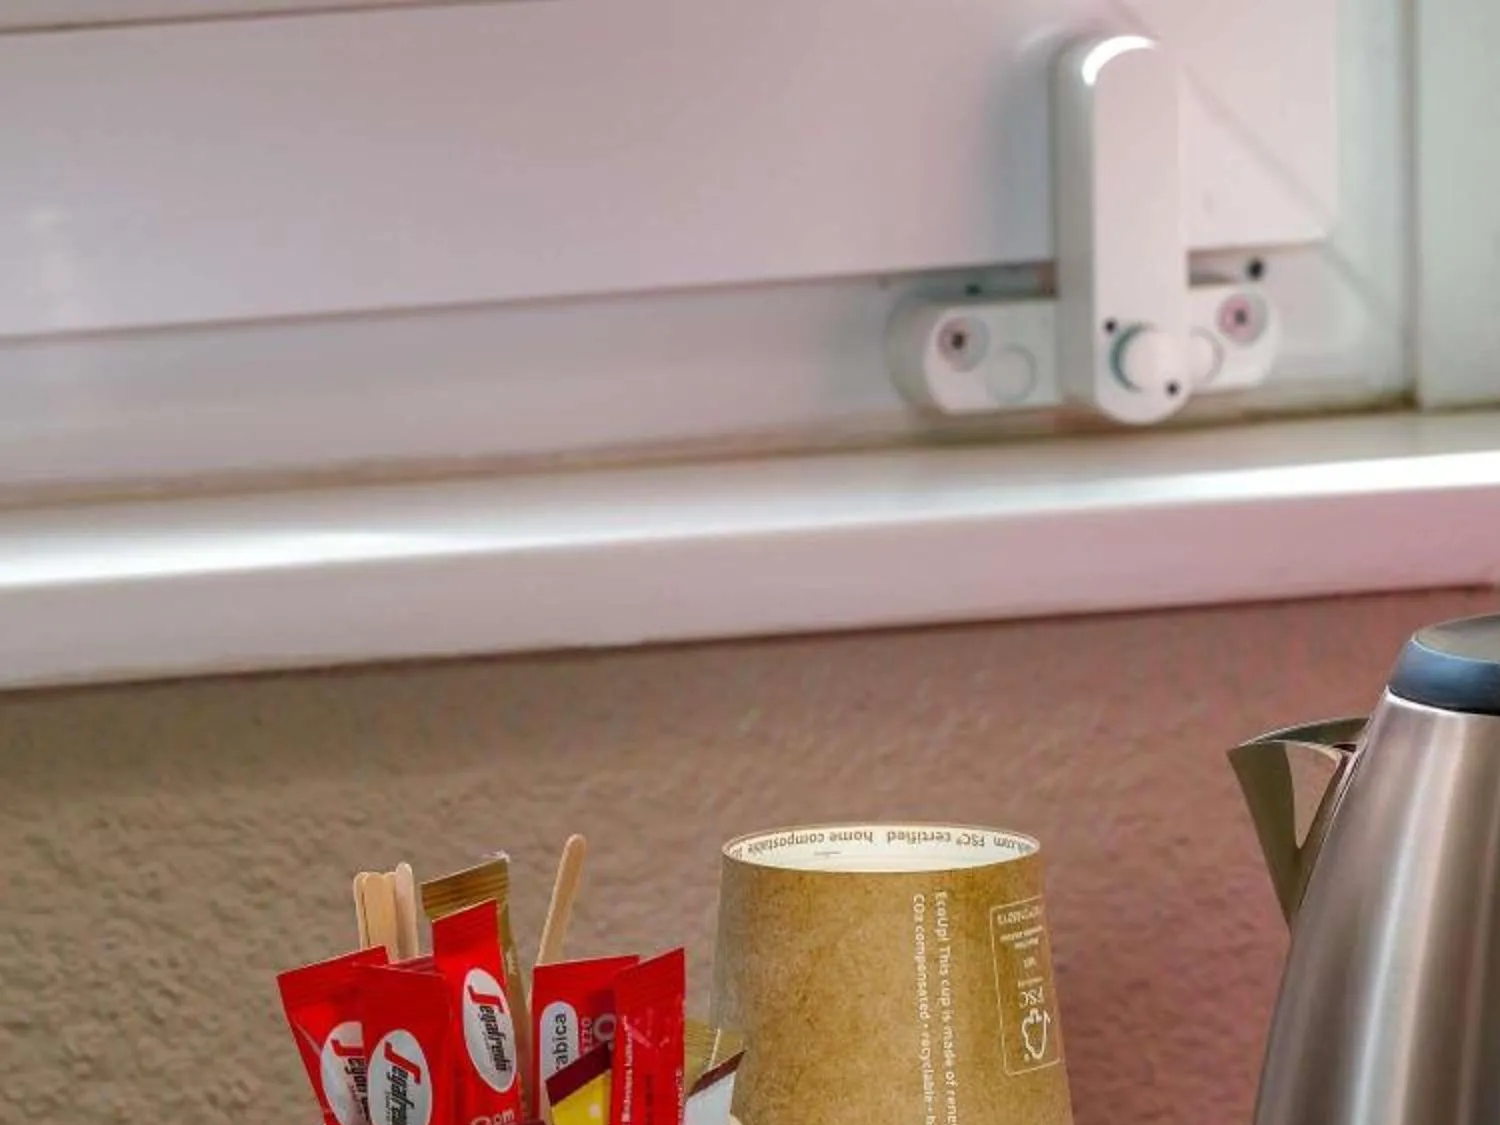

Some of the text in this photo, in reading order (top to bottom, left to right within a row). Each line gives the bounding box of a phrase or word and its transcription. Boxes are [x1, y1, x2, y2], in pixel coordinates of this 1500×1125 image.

[747, 831, 826, 857] compostable
[829, 830, 874, 845] home
[886, 830, 952, 846] certified
[914, 925, 932, 1020] compensated
[938, 945, 952, 976] This
[938, 978, 952, 1006] cup
[468, 985, 511, 1073] Segafredo
[941, 1008, 955, 1022] is
[943, 1025, 957, 1067] made
[918, 1031, 936, 1103] recyclable
[945, 1070, 959, 1089] of
